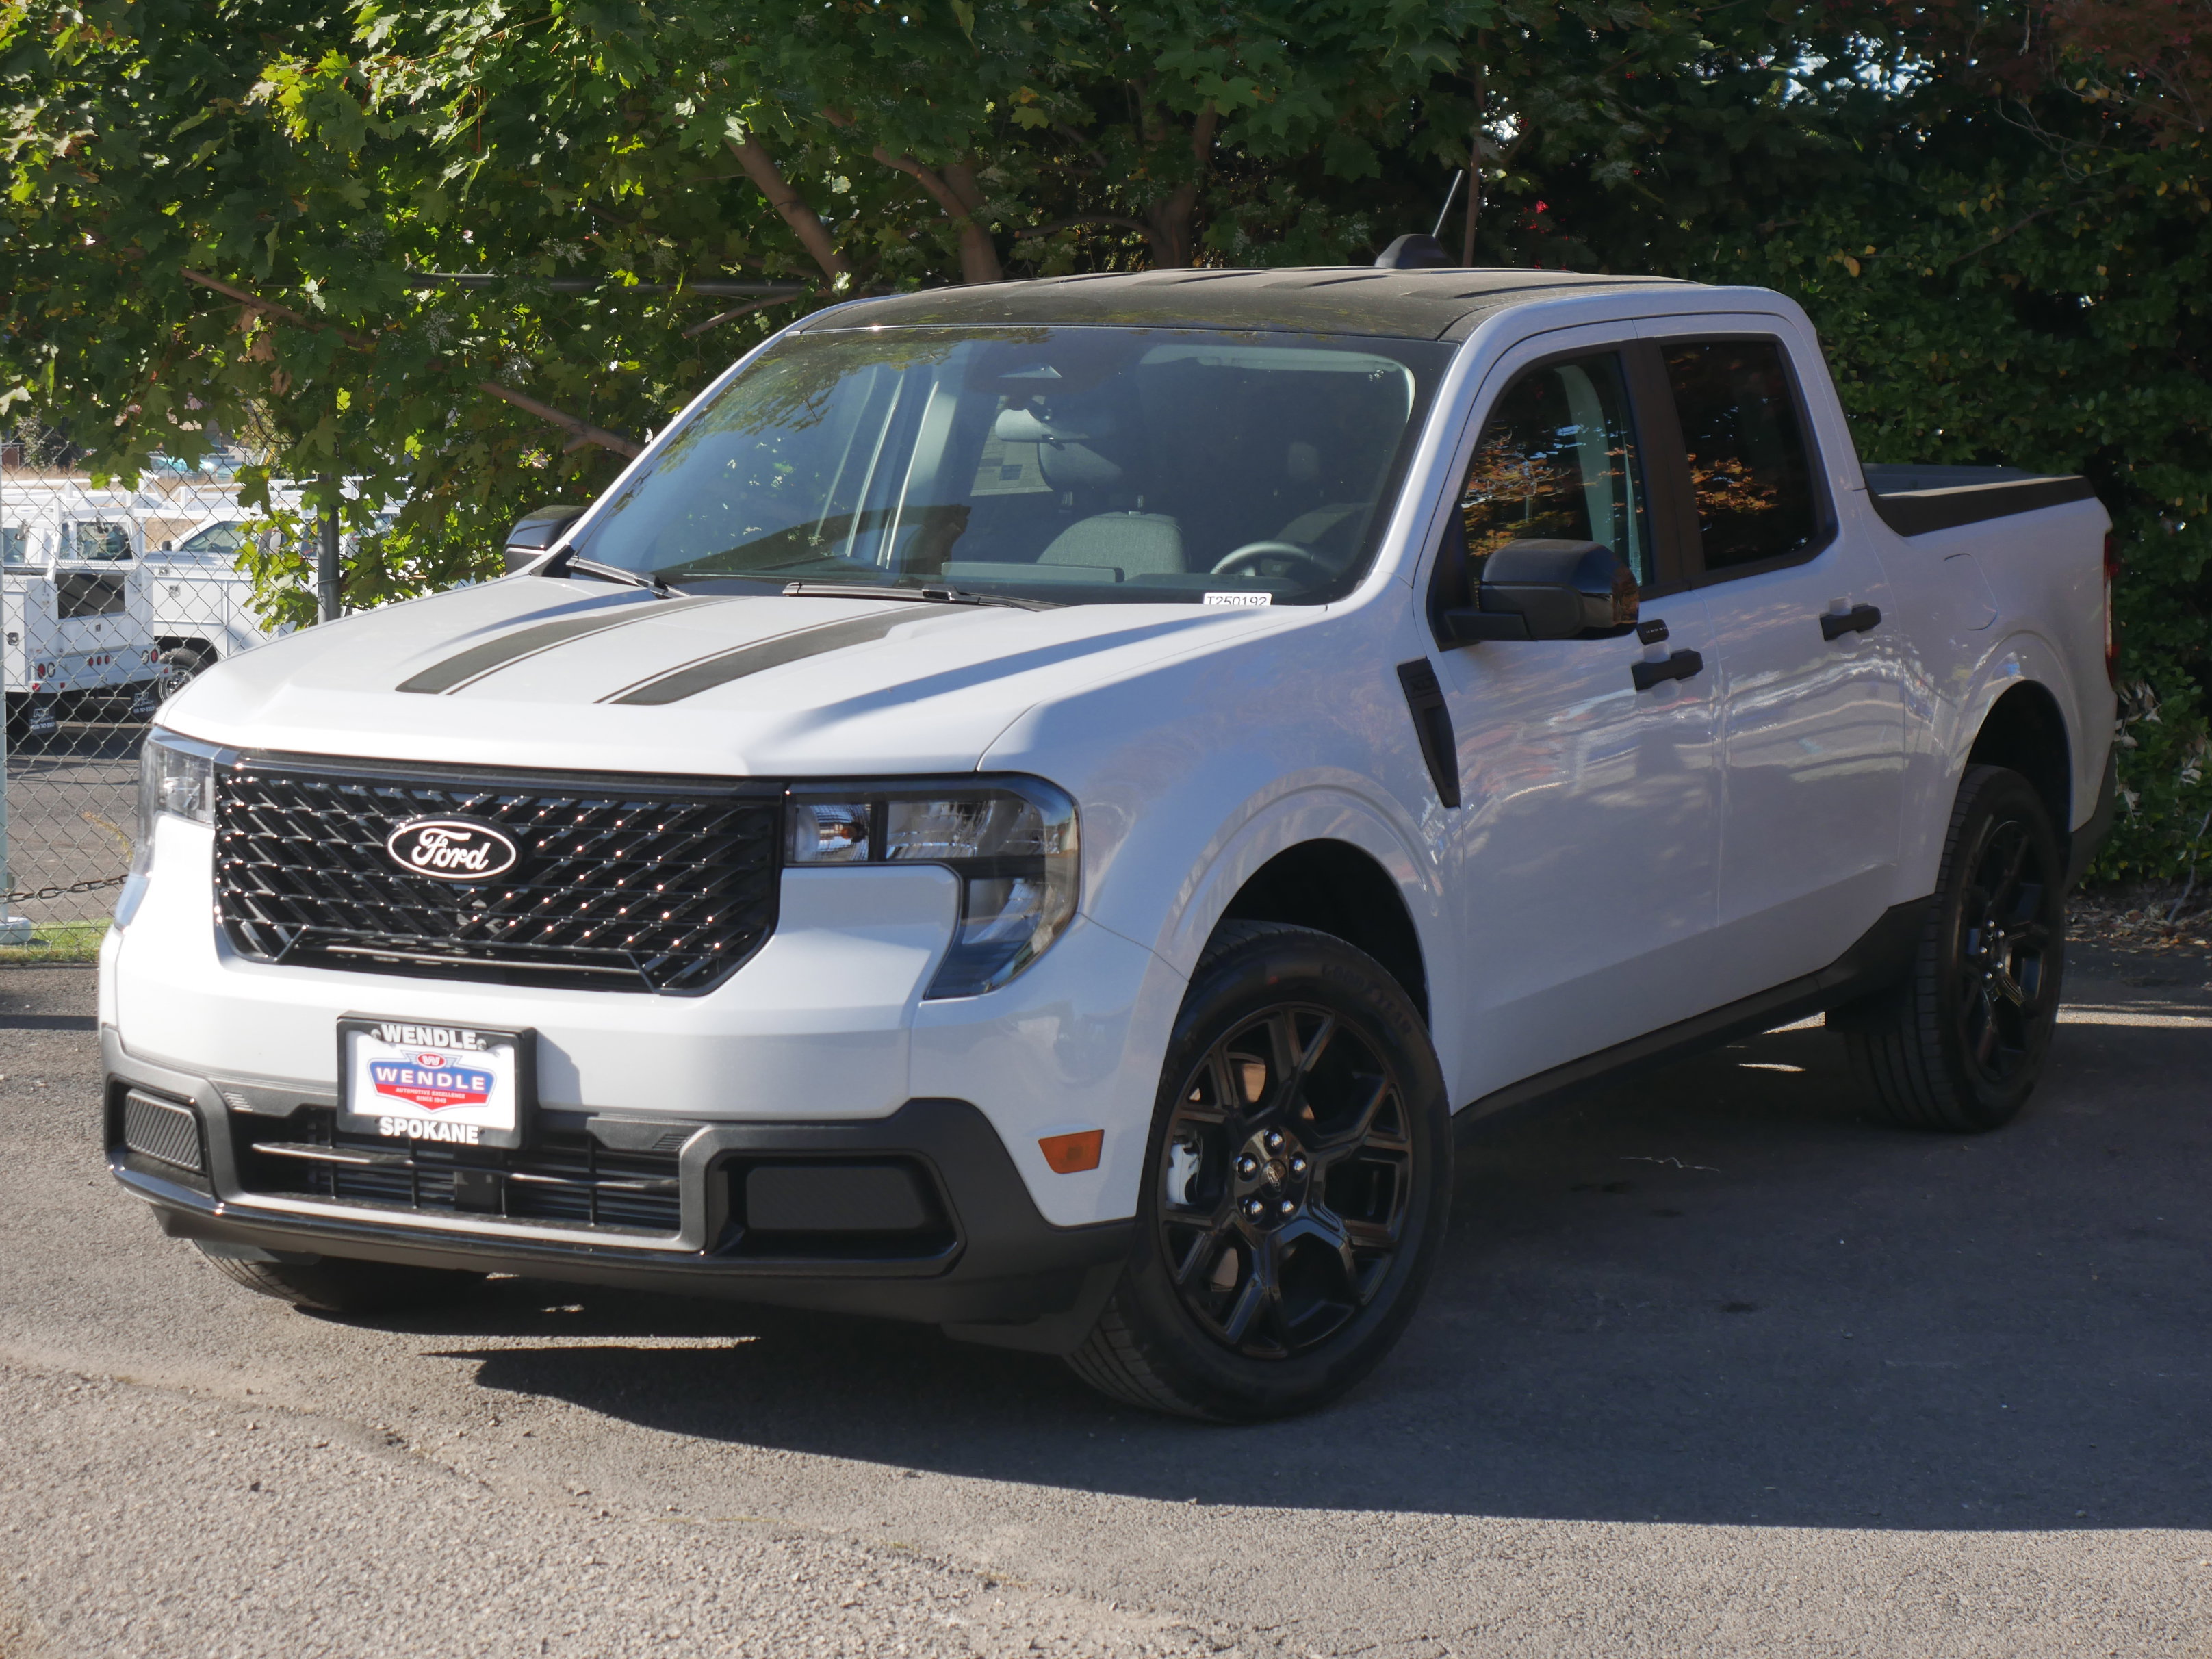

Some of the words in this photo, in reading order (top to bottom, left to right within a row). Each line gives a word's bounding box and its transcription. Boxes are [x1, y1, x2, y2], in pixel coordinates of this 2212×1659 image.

[1207, 596, 1267, 605] T250192
[411, 827, 491, 870] Ford
[381, 1023, 476, 1050] WENDLE
[421, 1054, 441, 1066] W
[376, 1067, 485, 1090] WENDLE
[396, 1087, 430, 1096] AUTOMOTIVE
[431, 1090, 465, 1099] EXCELLENCE
[379, 1116, 479, 1145] SPOKANE
